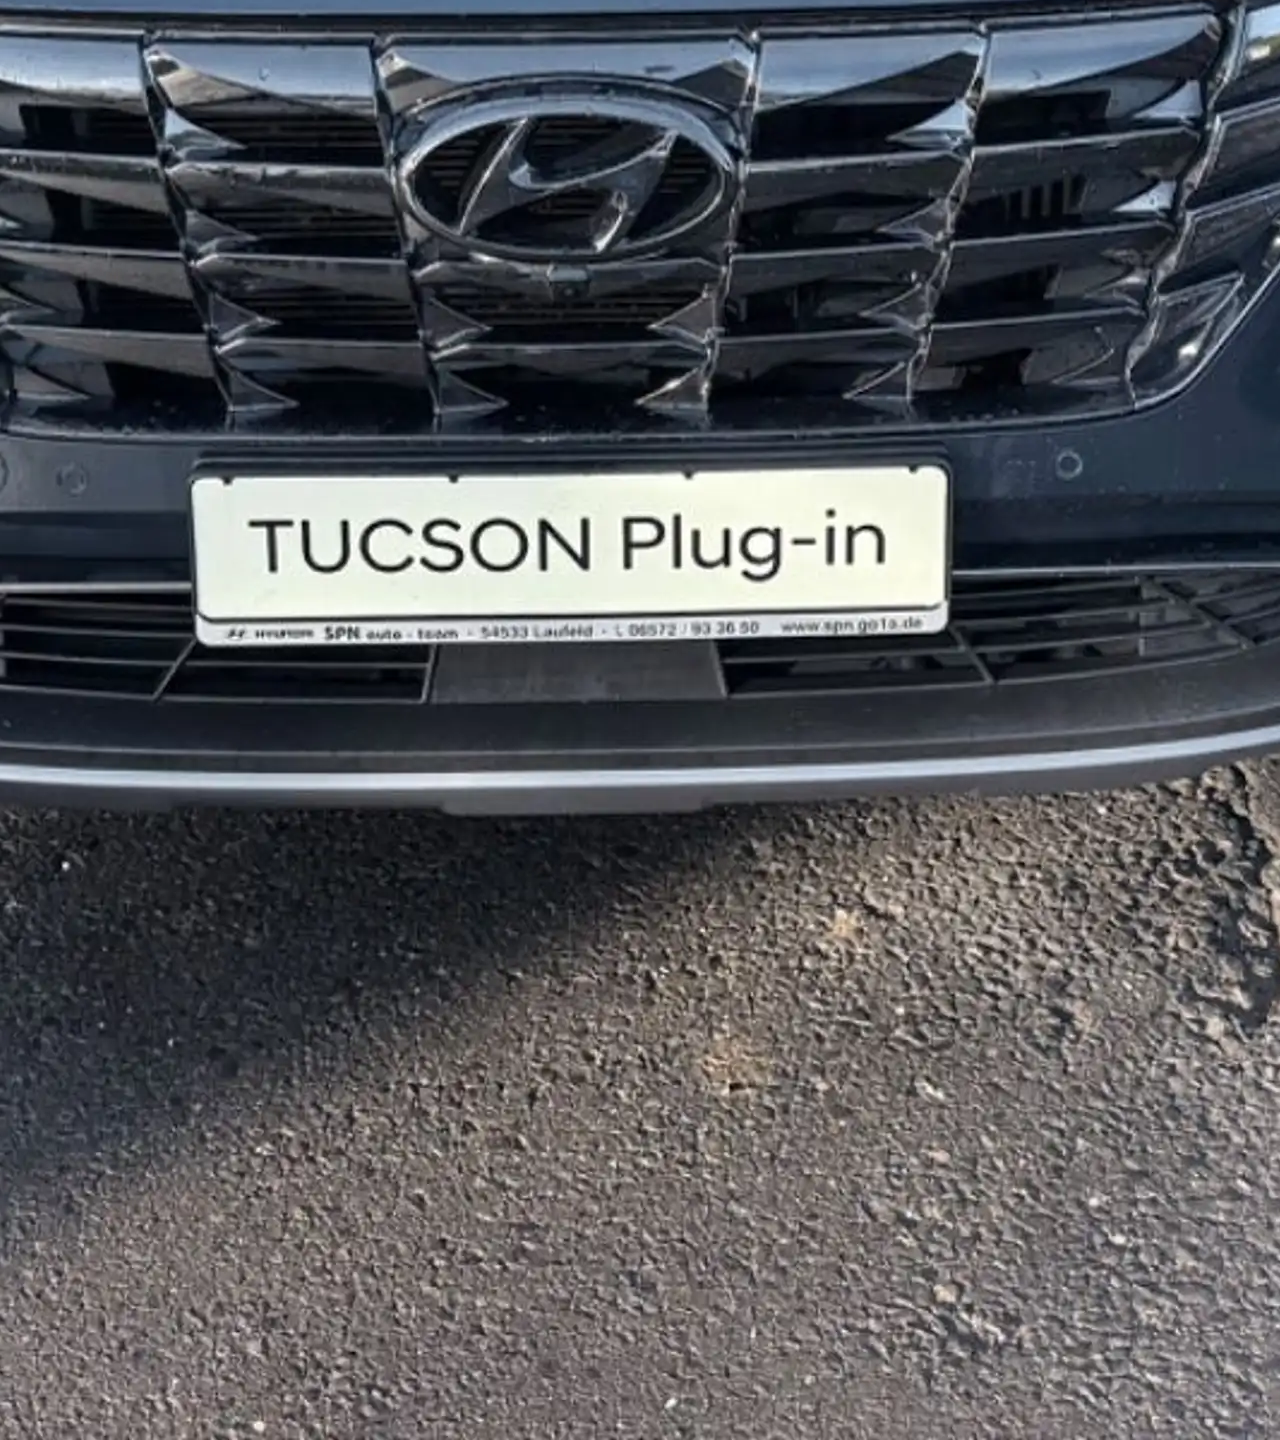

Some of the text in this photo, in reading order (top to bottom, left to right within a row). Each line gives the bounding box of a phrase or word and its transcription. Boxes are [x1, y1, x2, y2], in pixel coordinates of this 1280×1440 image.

[247, 509, 887, 582] TUCSON Plug-in
[324, 626, 361, 640] SPN
[365, 629, 402, 640] auto
[417, 627, 460, 640] team
